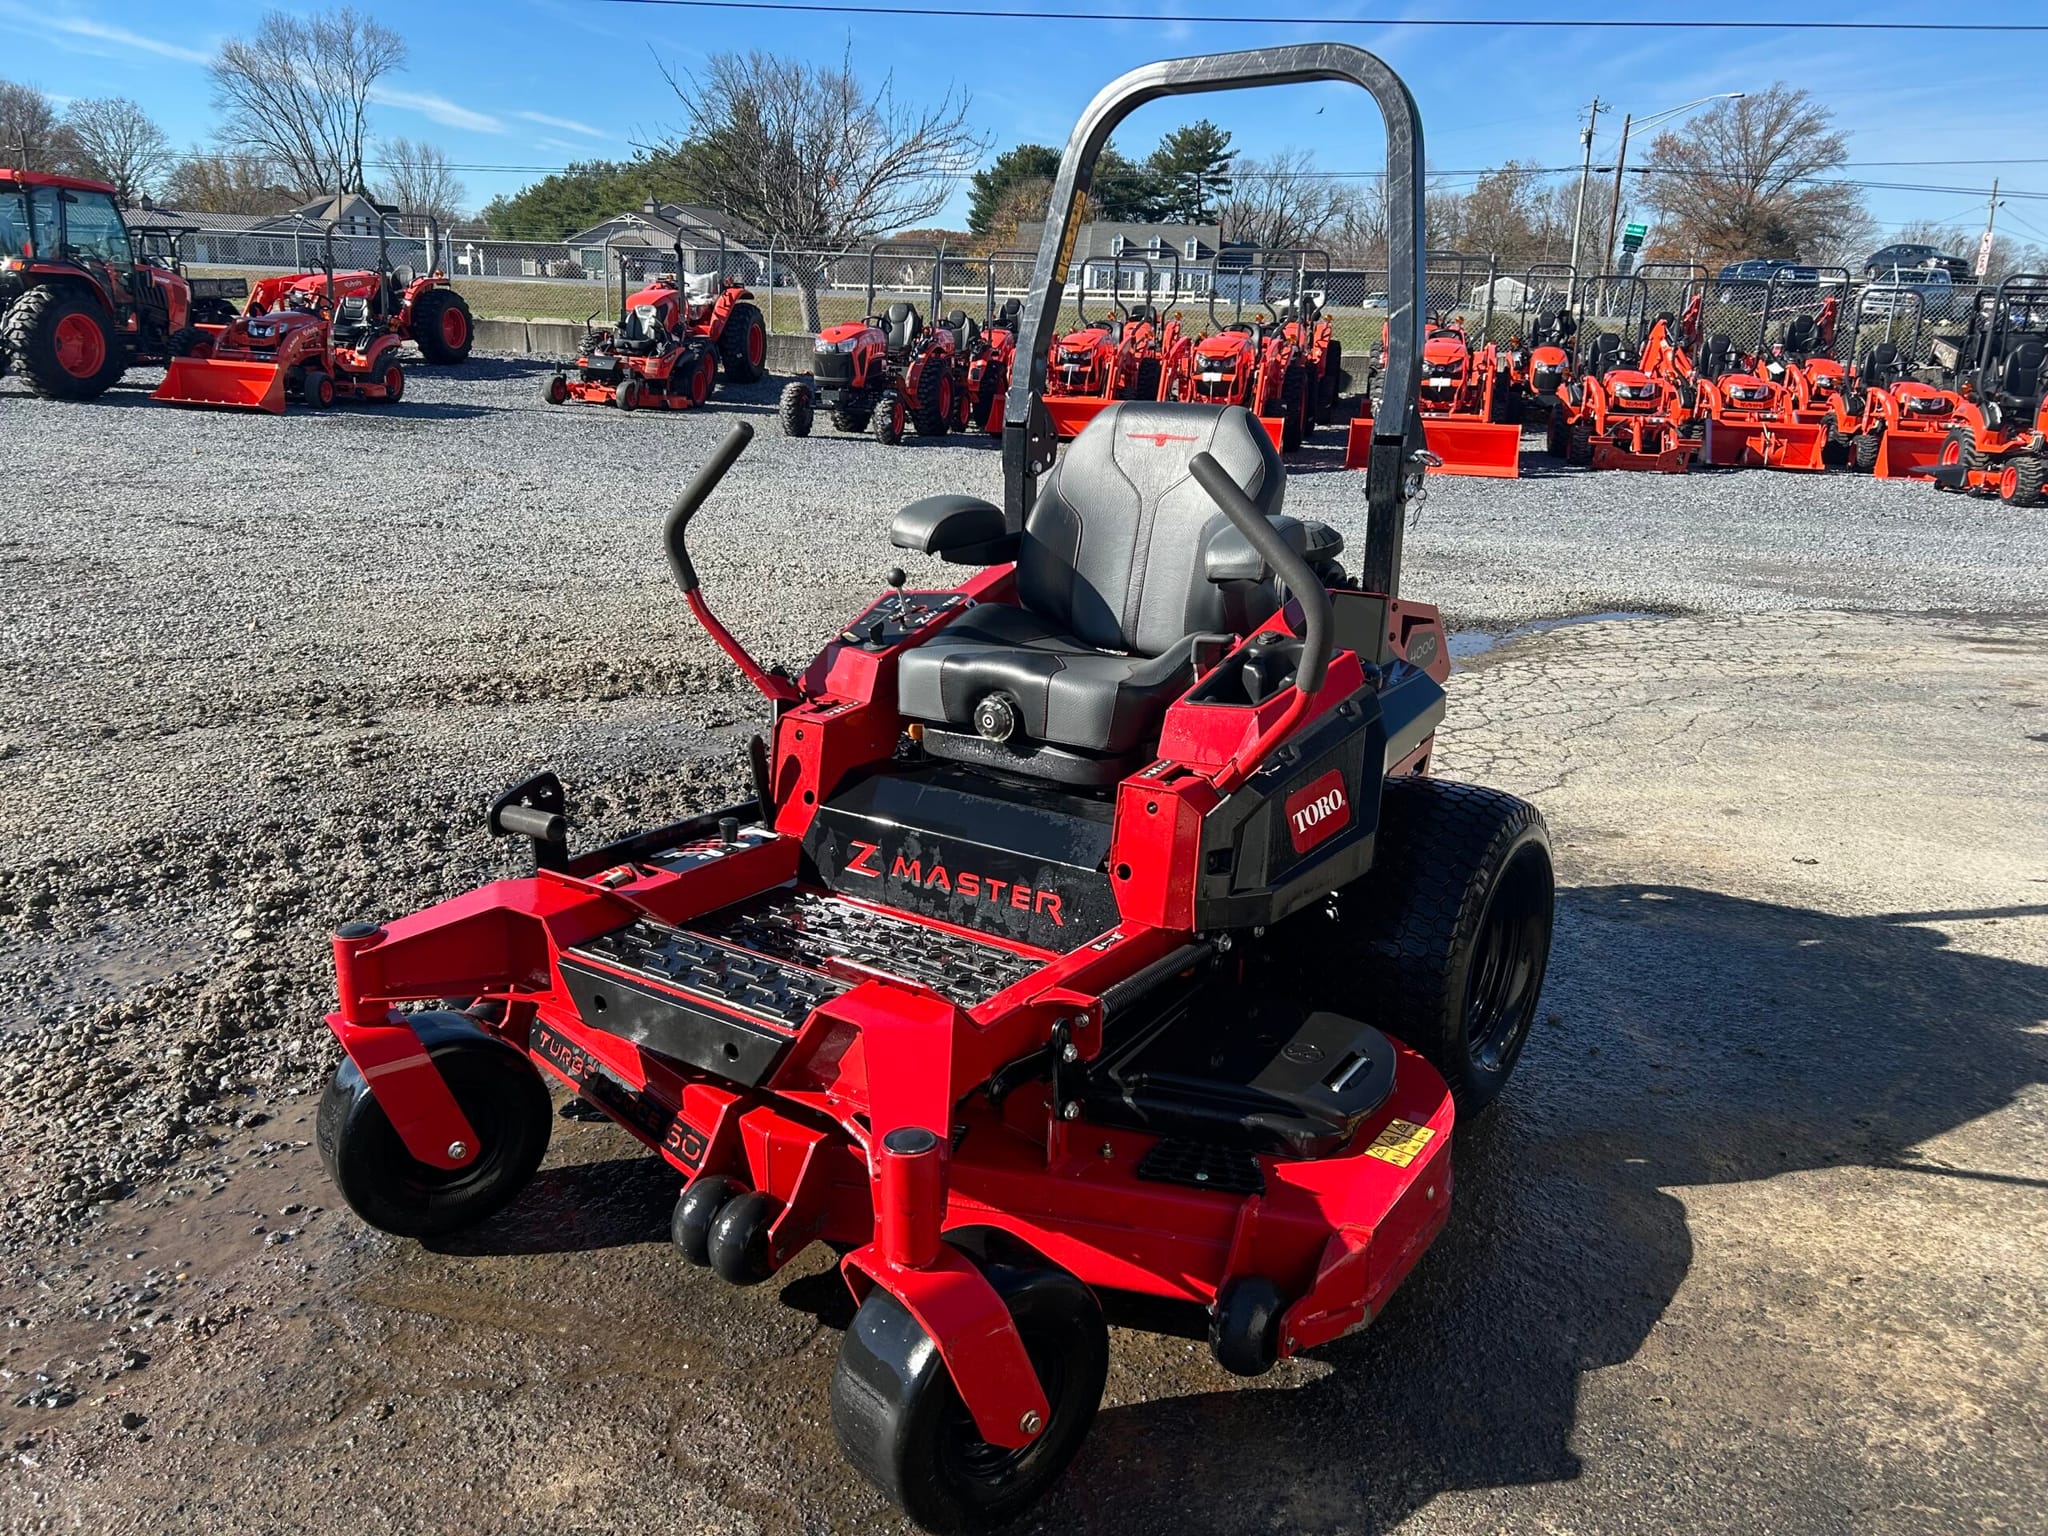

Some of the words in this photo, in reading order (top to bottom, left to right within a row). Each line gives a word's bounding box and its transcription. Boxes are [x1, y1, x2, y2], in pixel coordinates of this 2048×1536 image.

[1409, 636, 1436, 662] 4000
[1292, 788, 1343, 834] TORO
[844, 839, 881, 878] Z
[891, 855, 1064, 927] MASTER
[540, 1030, 597, 1082] TURBO
